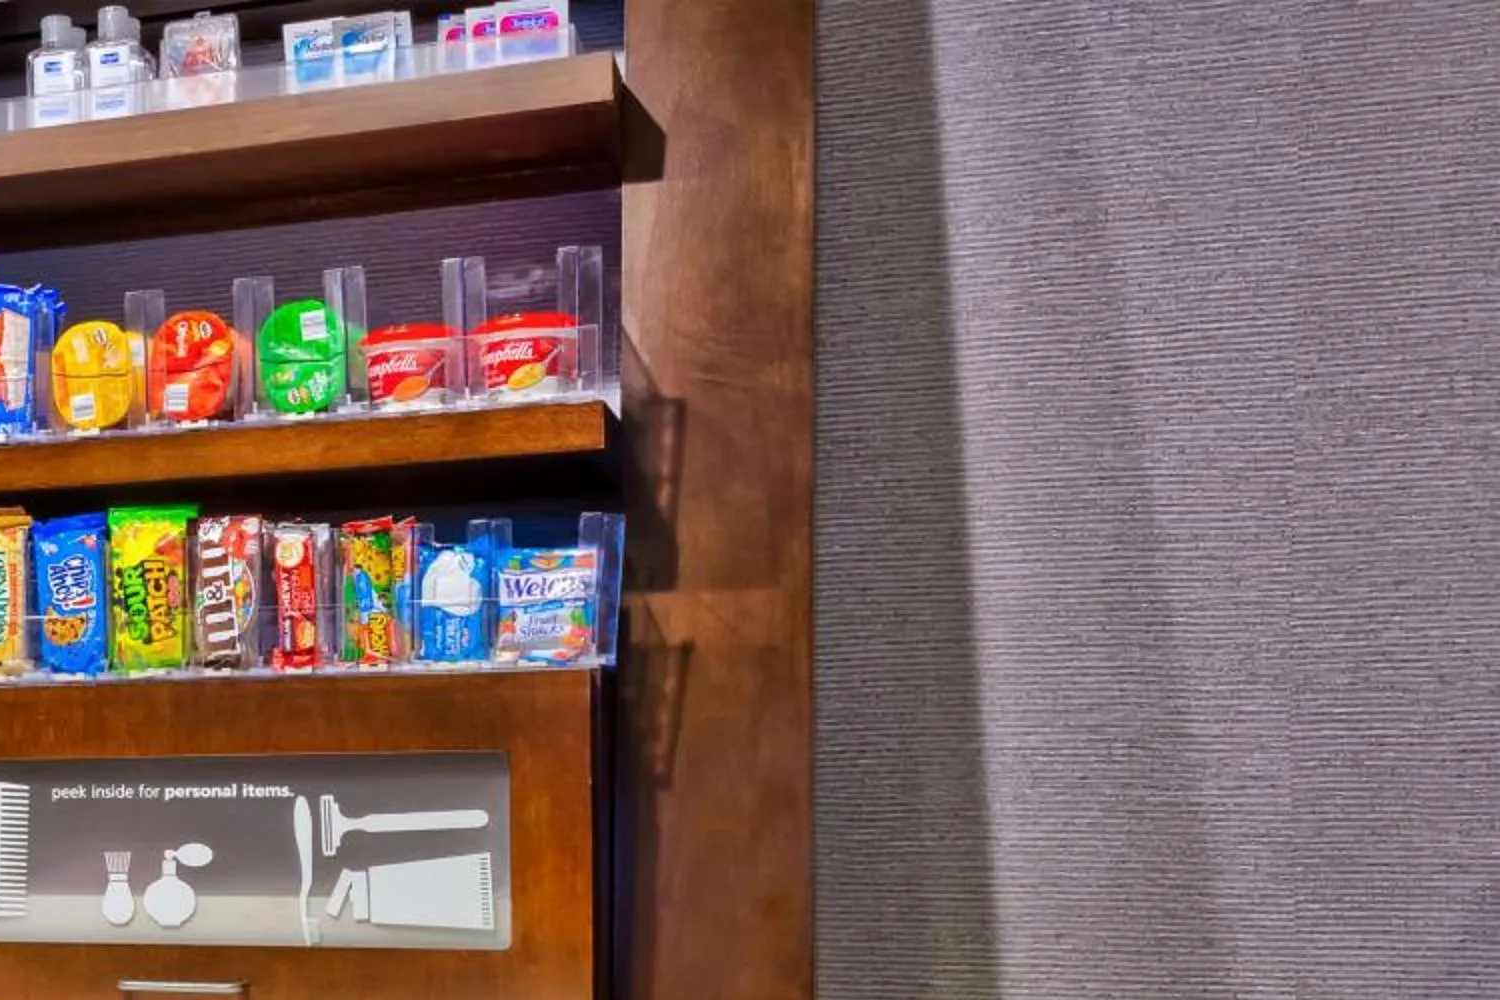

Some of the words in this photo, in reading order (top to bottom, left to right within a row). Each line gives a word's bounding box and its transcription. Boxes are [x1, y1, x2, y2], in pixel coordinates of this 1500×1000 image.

[122, 565, 148, 641] SOUR
[145, 560, 170, 641] PATCH
[51, 784, 87, 802] peek
[92, 784, 134, 799] inside
[139, 783, 161, 798] for
[164, 783, 237, 802] personal
[242, 782, 295, 798] items.
